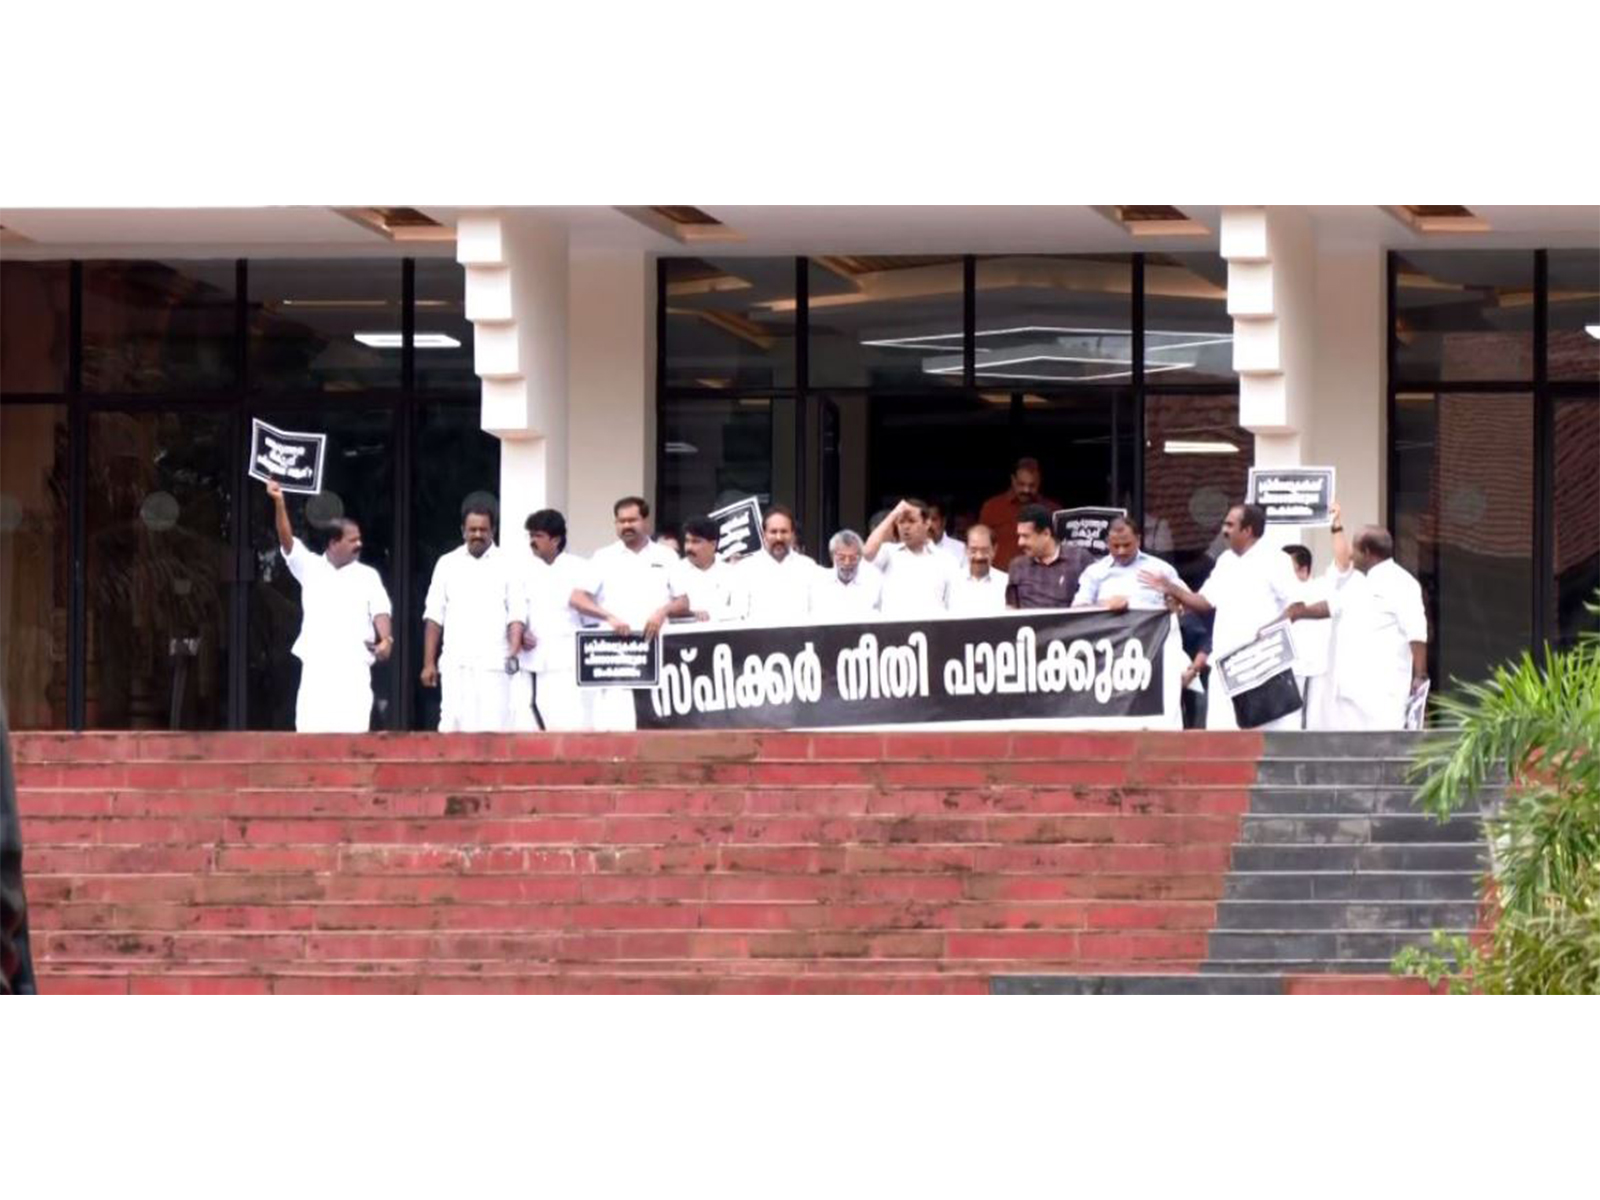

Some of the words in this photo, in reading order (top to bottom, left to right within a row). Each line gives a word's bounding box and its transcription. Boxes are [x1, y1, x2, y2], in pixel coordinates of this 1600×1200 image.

[651, 642, 822, 717] സ്പീക്കർ
[836, 631, 929, 700] നീതി
[943, 626, 1152, 704] പാലിക്കുക
